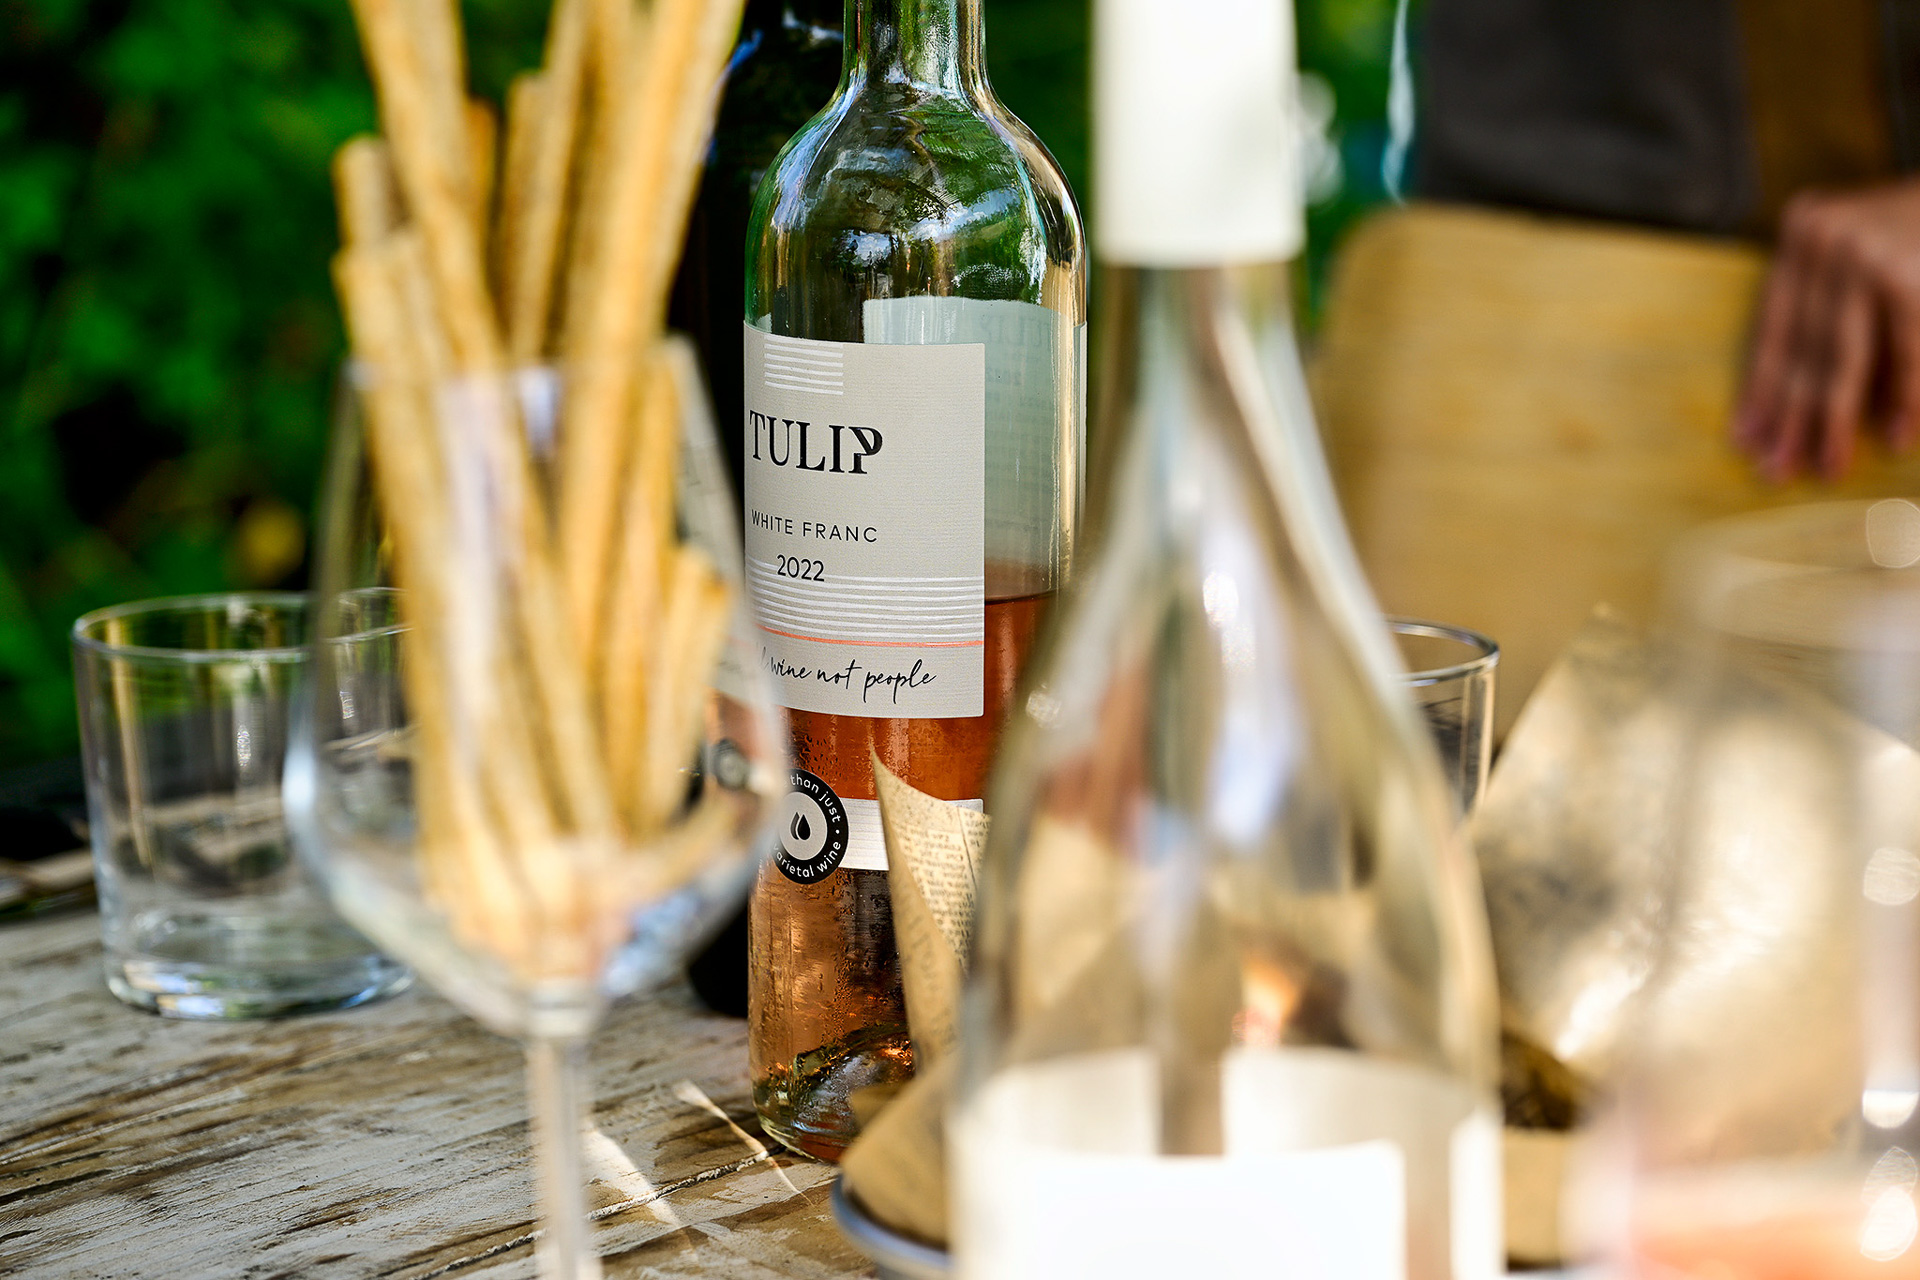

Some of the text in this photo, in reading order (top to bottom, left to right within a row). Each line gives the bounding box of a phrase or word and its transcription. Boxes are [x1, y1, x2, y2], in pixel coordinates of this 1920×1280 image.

[749, 409, 883, 475] TULIP
[751, 509, 878, 543] WHITE FRANC
[776, 554, 825, 582] 2022
[770, 656, 937, 704] wine not people
[790, 773, 841, 823] than just
[816, 841, 842, 873] wine
